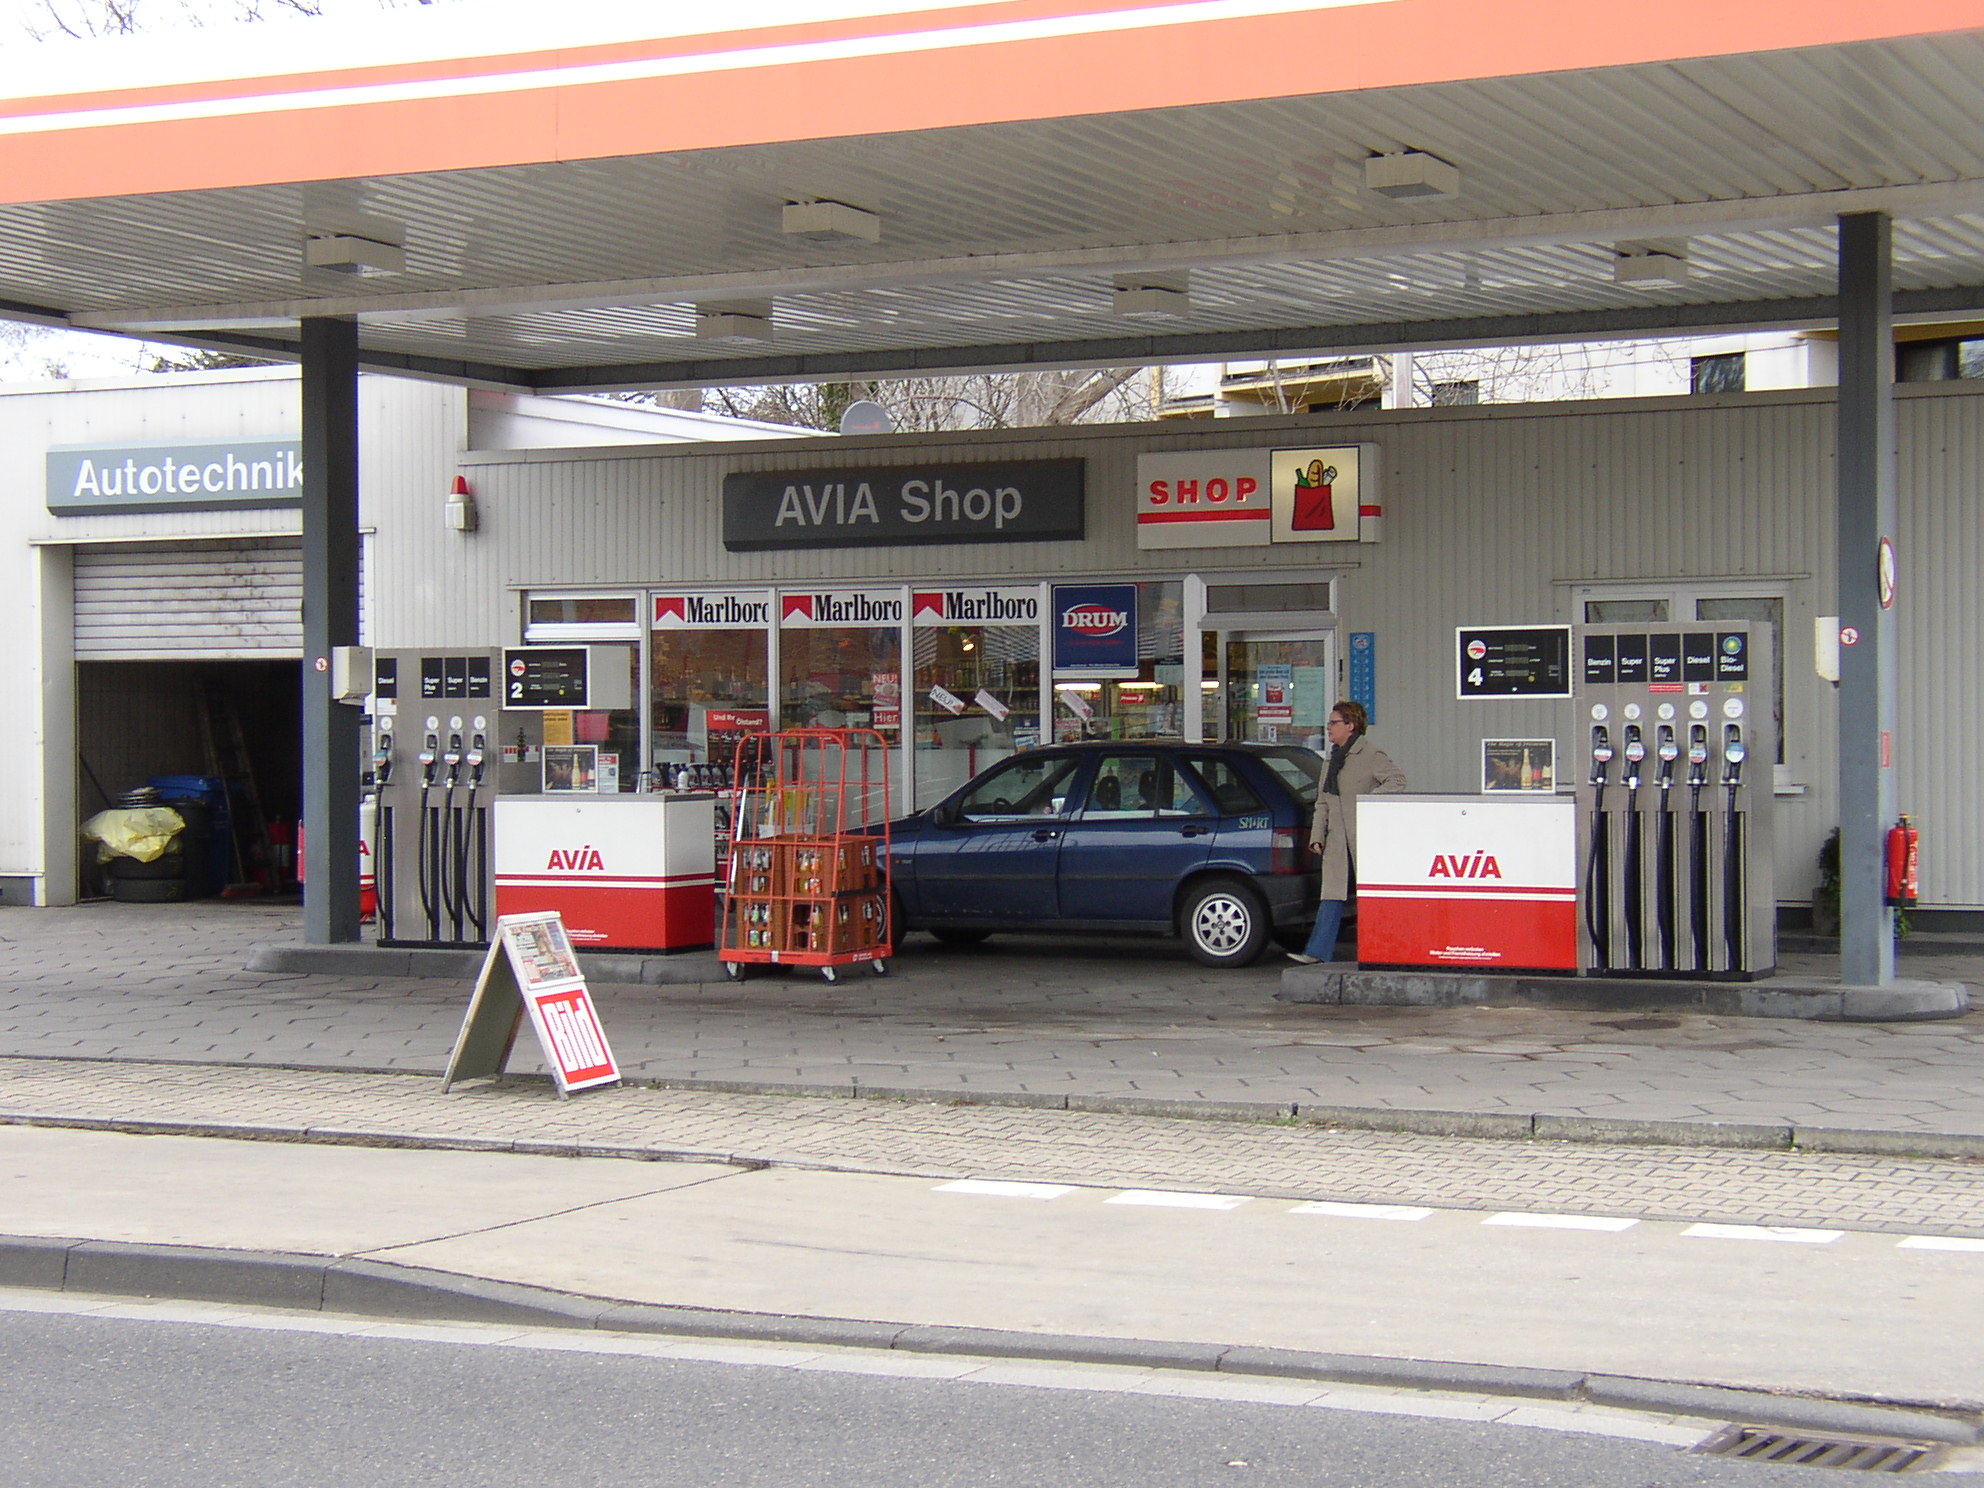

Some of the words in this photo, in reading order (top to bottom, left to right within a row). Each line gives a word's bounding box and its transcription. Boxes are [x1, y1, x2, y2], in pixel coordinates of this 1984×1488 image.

[74, 451, 303, 496] Autotechnik
[1149, 477, 1258, 506] SHOP
[775, 482, 879, 527] AVIA
[900, 479, 1022, 529] Shop
[814, 593, 902, 622] Marlboro
[946, 592, 1038, 620] Marlboro
[1062, 611, 1128, 628] DRUM
[1587, 658, 1612, 666] Benzin
[1621, 657, 1643, 666] Super
[1654, 657, 1676, 666] Super
[1687, 656, 1710, 664] Diesel
[1720, 664, 1744, 672] Diesel
[1467, 667, 1484, 686] 4
[1654, 665, 1670, 673] Plus
[872, 673, 898, 684] NEU!
[511, 682, 524, 699] 2
[873, 711, 898, 723] Hier
[541, 997, 609, 1073] Bild
